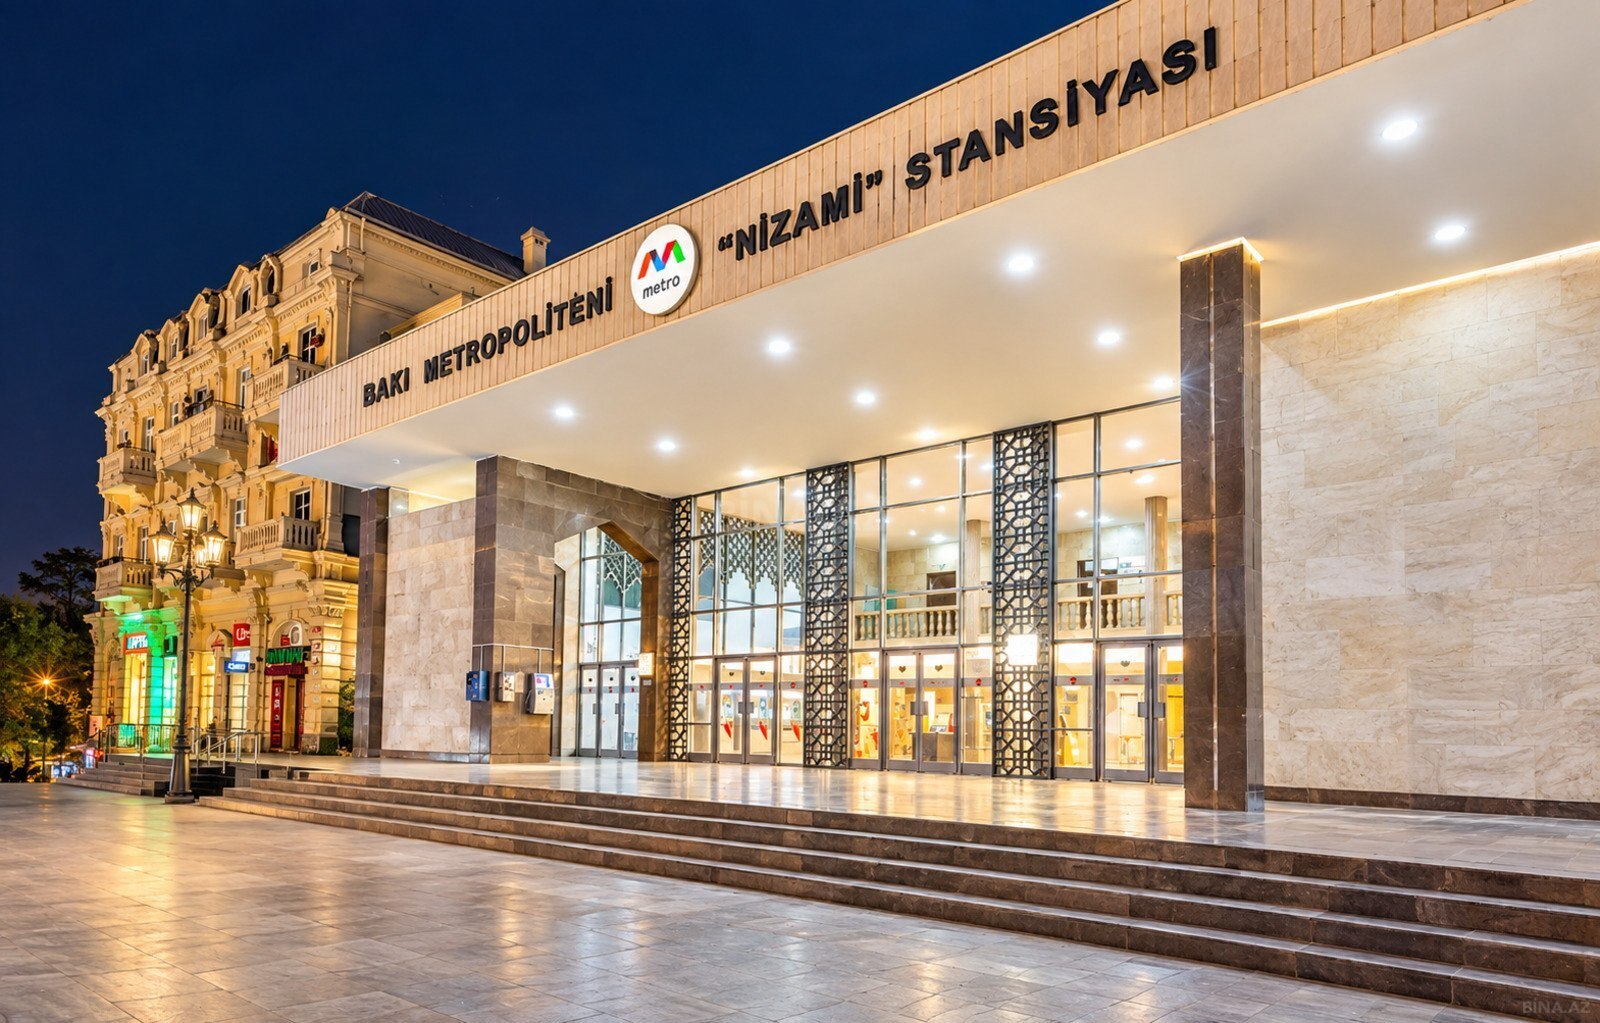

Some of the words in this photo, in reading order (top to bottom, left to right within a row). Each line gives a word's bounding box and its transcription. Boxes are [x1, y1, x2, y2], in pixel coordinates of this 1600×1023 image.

[905, 26, 1217, 190] STANSİYASI
[642, 275, 681, 300] metro
[363, 366, 410, 408] BAKI
